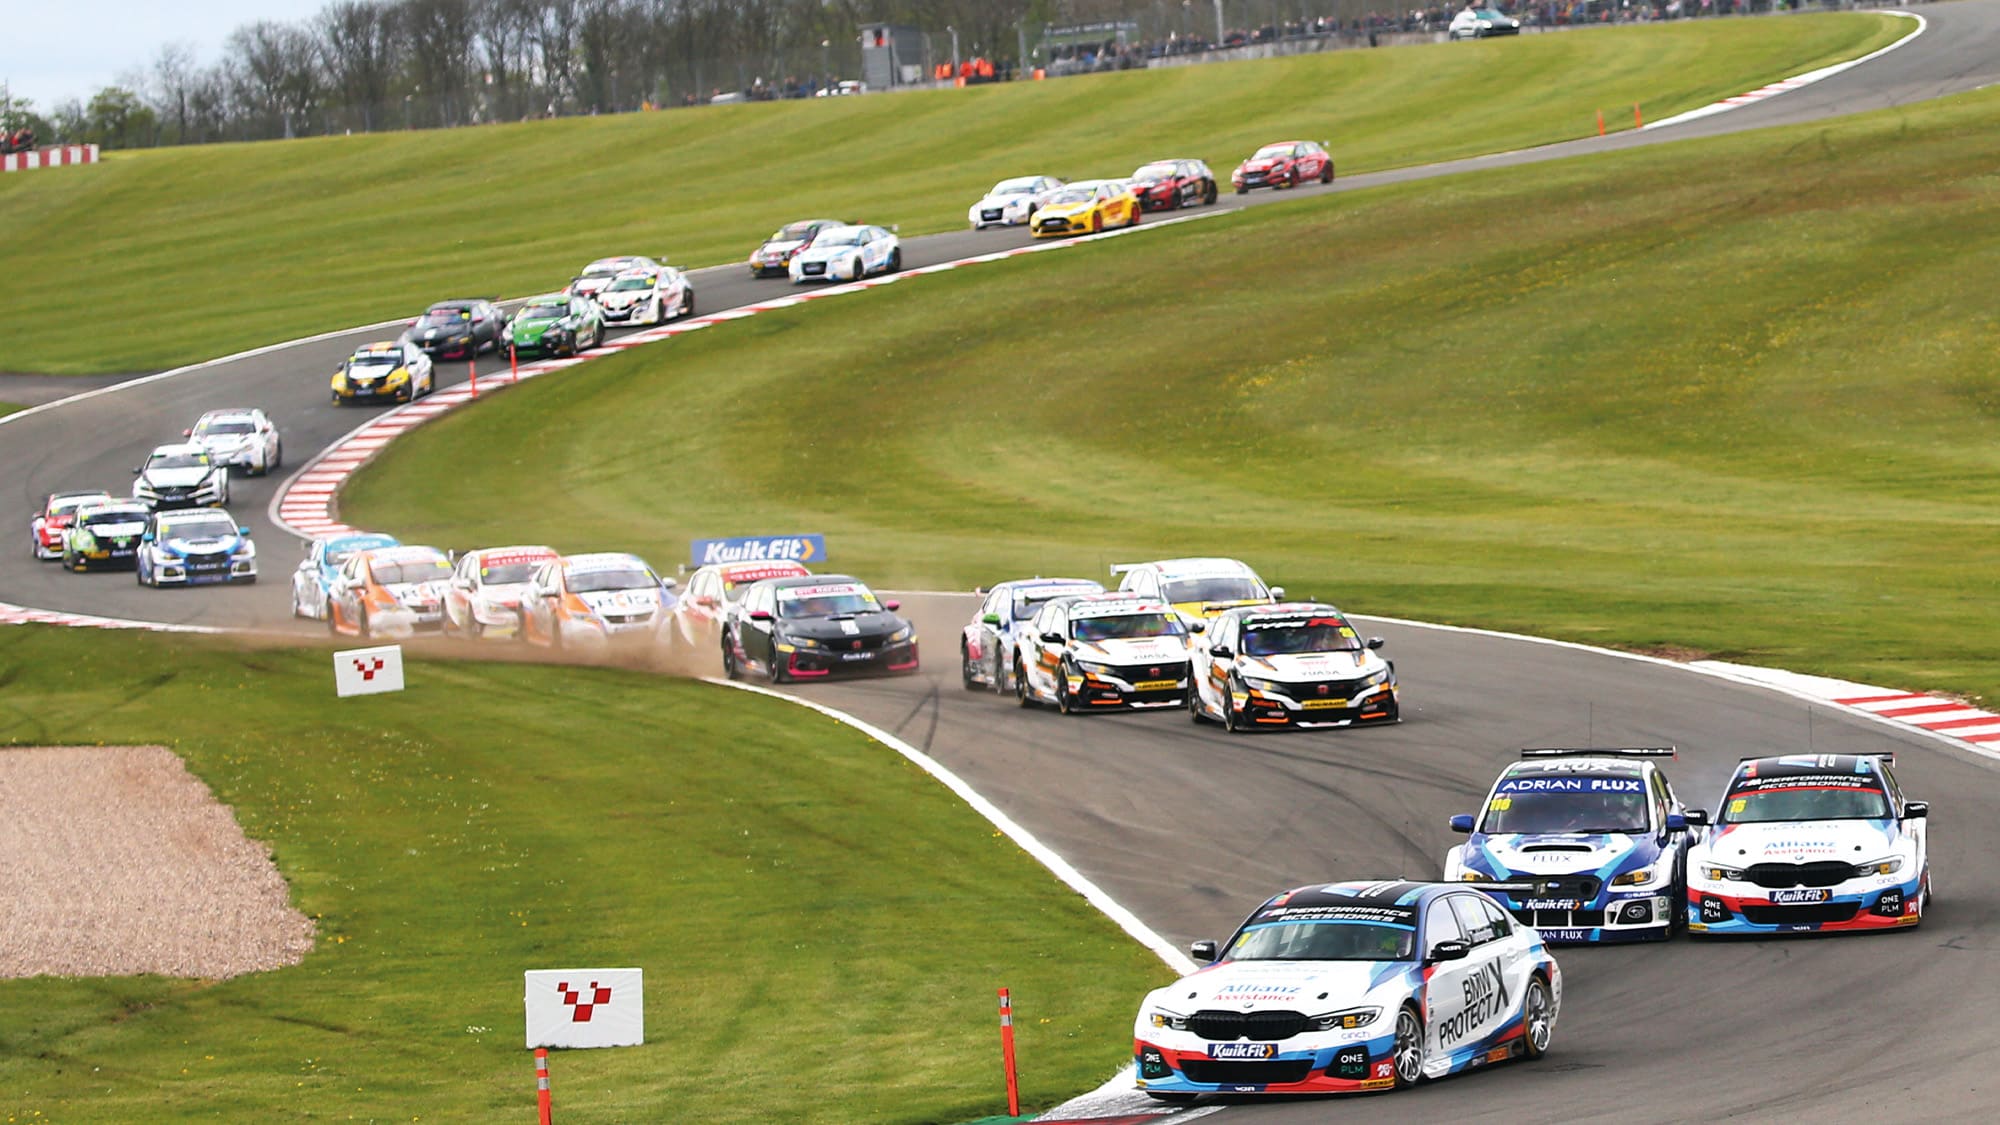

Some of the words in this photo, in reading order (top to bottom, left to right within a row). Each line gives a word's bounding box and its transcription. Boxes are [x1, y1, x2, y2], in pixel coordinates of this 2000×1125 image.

[1502, 780, 1582, 791] ADRIAN
[1591, 780, 1640, 791] FLUX
[1764, 840, 1838, 849] Allianz
[1881, 895, 1899, 904] ONE
[1704, 900, 1721, 909] ONE
[1881, 904, 1899, 913] PLM
[1285, 906, 1413, 918] PERFORMANCE
[1704, 908, 1721, 918] PLM
[1278, 913, 1396, 922] ACCESSORIES
[1560, 930, 1583, 939] FLUX
[1217, 984, 1302, 993] Allianz
[1462, 966, 1492, 1006] BMW
[1213, 994, 1297, 1002] Assistance
[1439, 993, 1494, 1050] PROTECT
[1145, 1053, 1160, 1063] ONE
[1341, 1054, 1364, 1064] ONE
[1145, 1064, 1161, 1073] PLM
[1341, 1065, 1364, 1073] PLM
